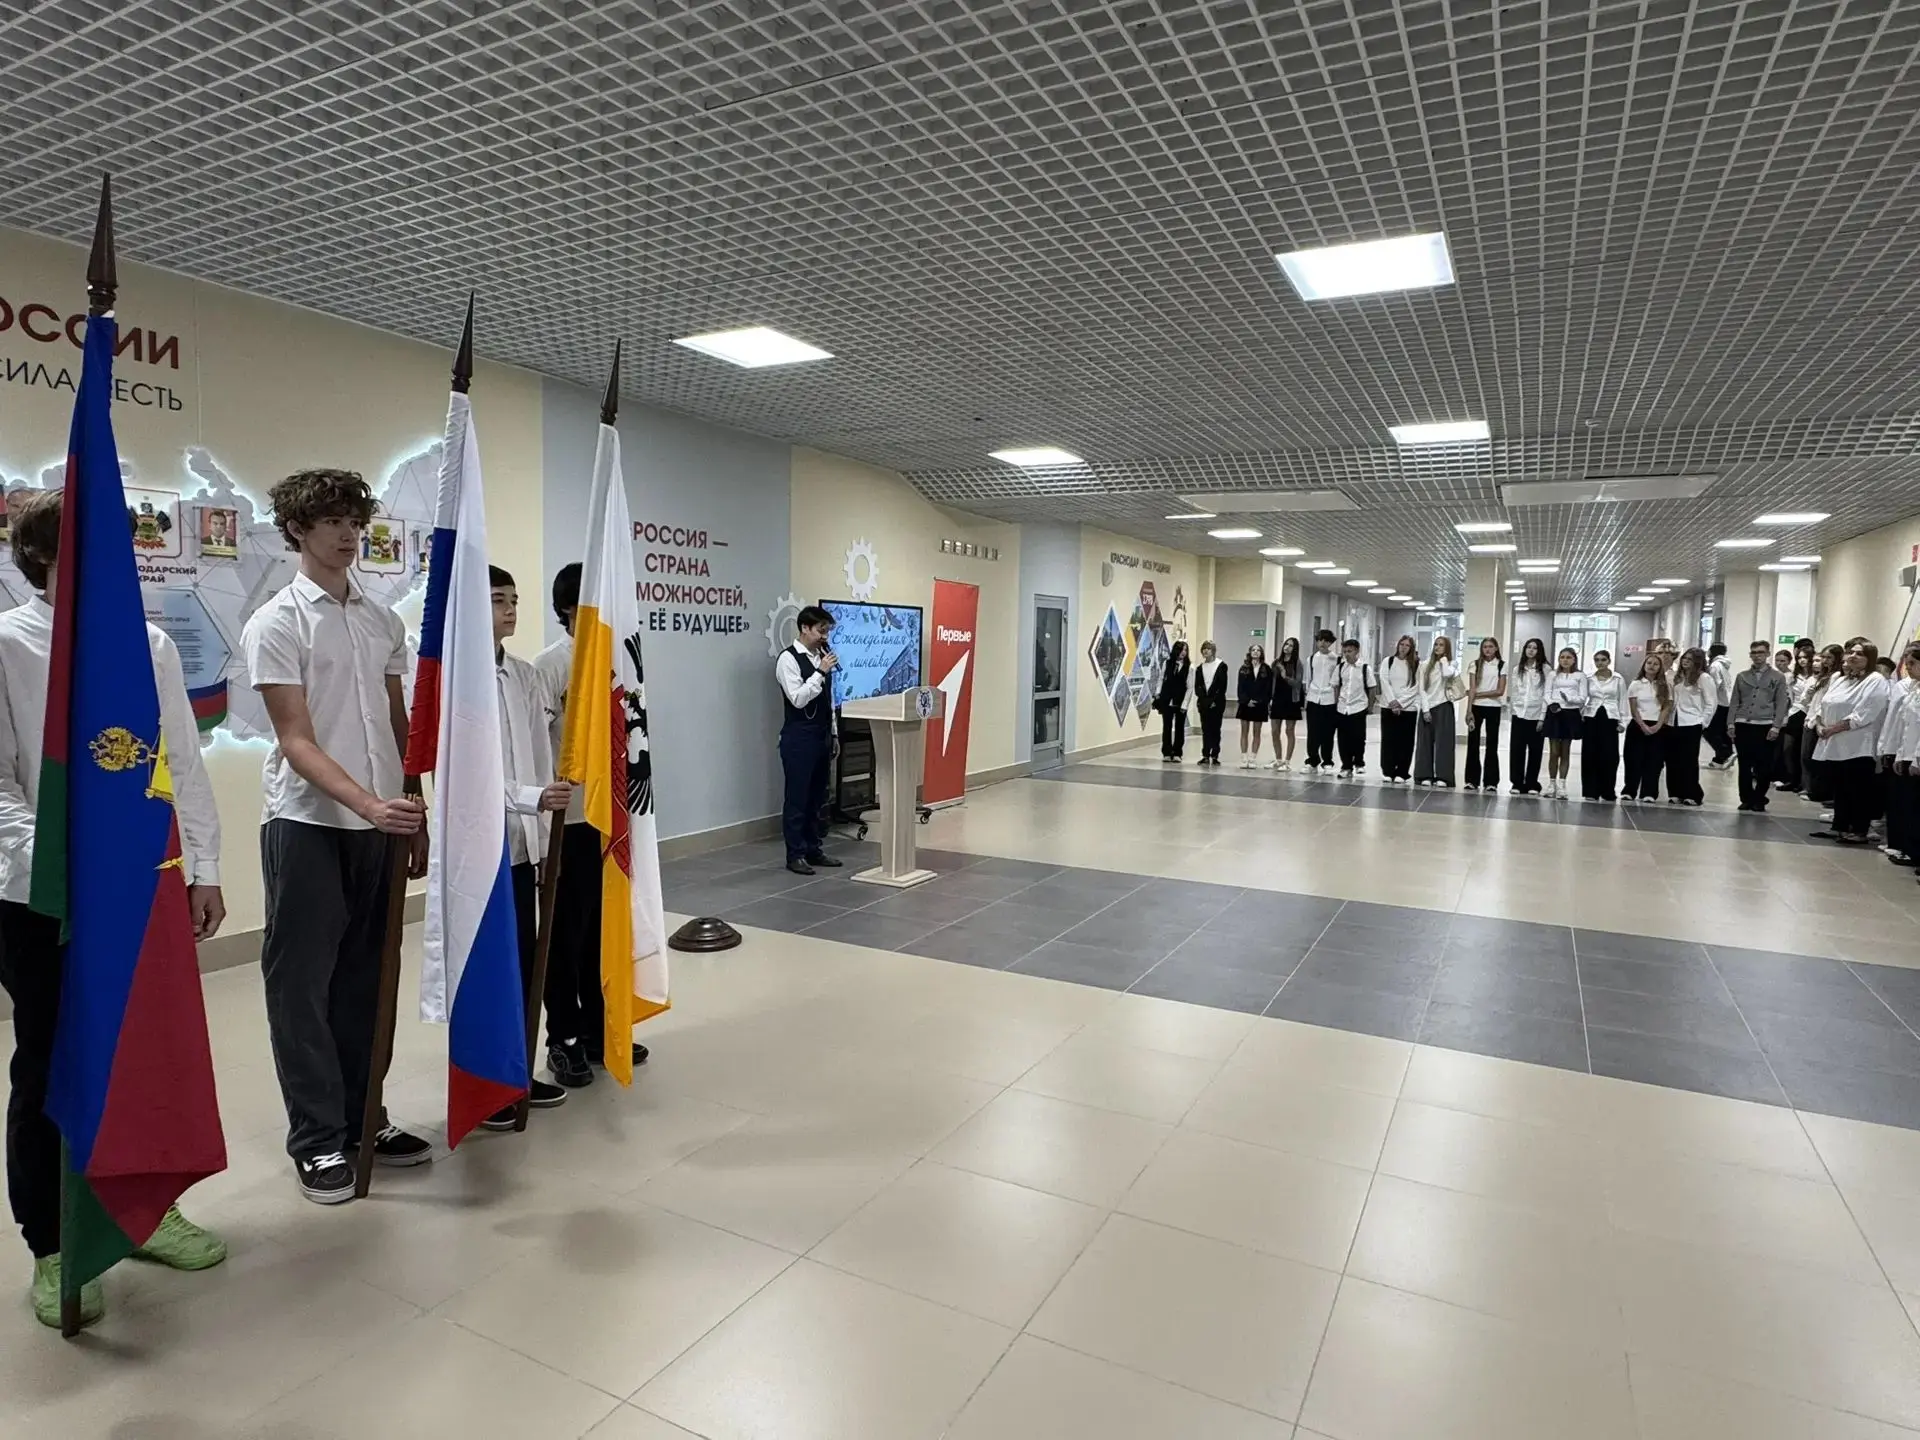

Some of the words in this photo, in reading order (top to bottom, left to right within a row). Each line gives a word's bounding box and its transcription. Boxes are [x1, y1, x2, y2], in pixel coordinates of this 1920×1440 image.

[0, 358, 76, 393] ИЛА
[633, 521, 708, 549] РОССИЯ
[645, 553, 710, 577] СТРАНА
[650, 608, 667, 631] ЕЁ
[937, 625, 971, 646] Первые
